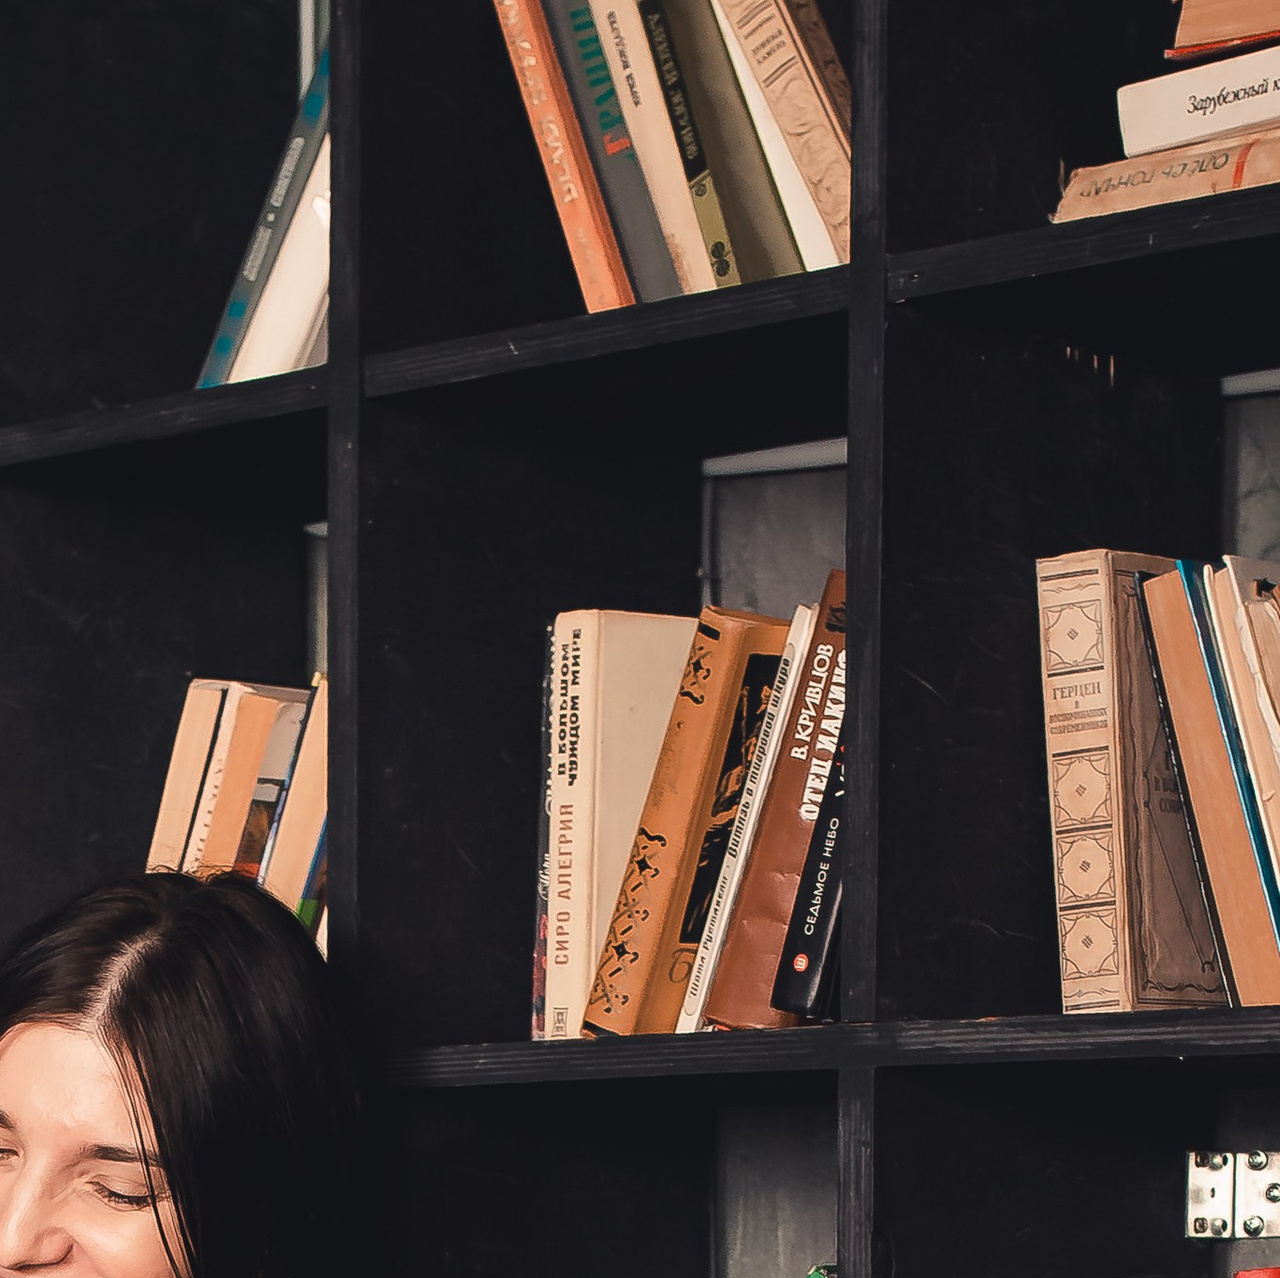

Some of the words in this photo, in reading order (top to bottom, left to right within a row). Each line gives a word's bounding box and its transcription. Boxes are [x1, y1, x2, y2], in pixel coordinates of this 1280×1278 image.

[1187, 78, 1269, 116] Зарубежный
[570, 628, 582, 686] МИРЕ
[558, 643, 570, 755] БОЛЬШОМ
[795, 643, 834, 743] КРИВЦОВ
[1052, 681, 1102, 701] ГЕРЦЕН
[568, 694, 581, 787] ЧУЖДОМ
[790, 744, 809, 761] В.
[800, 756, 833, 821] ОТЕЦ
[556, 803, 574, 901] АЛЕГРИЯ
[728, 800, 751, 859] Витязь
[804, 861, 830, 936] СЕДЬМОЕ
[822, 817, 840, 858] НЕБО
[555, 910, 571, 966] СИРО
